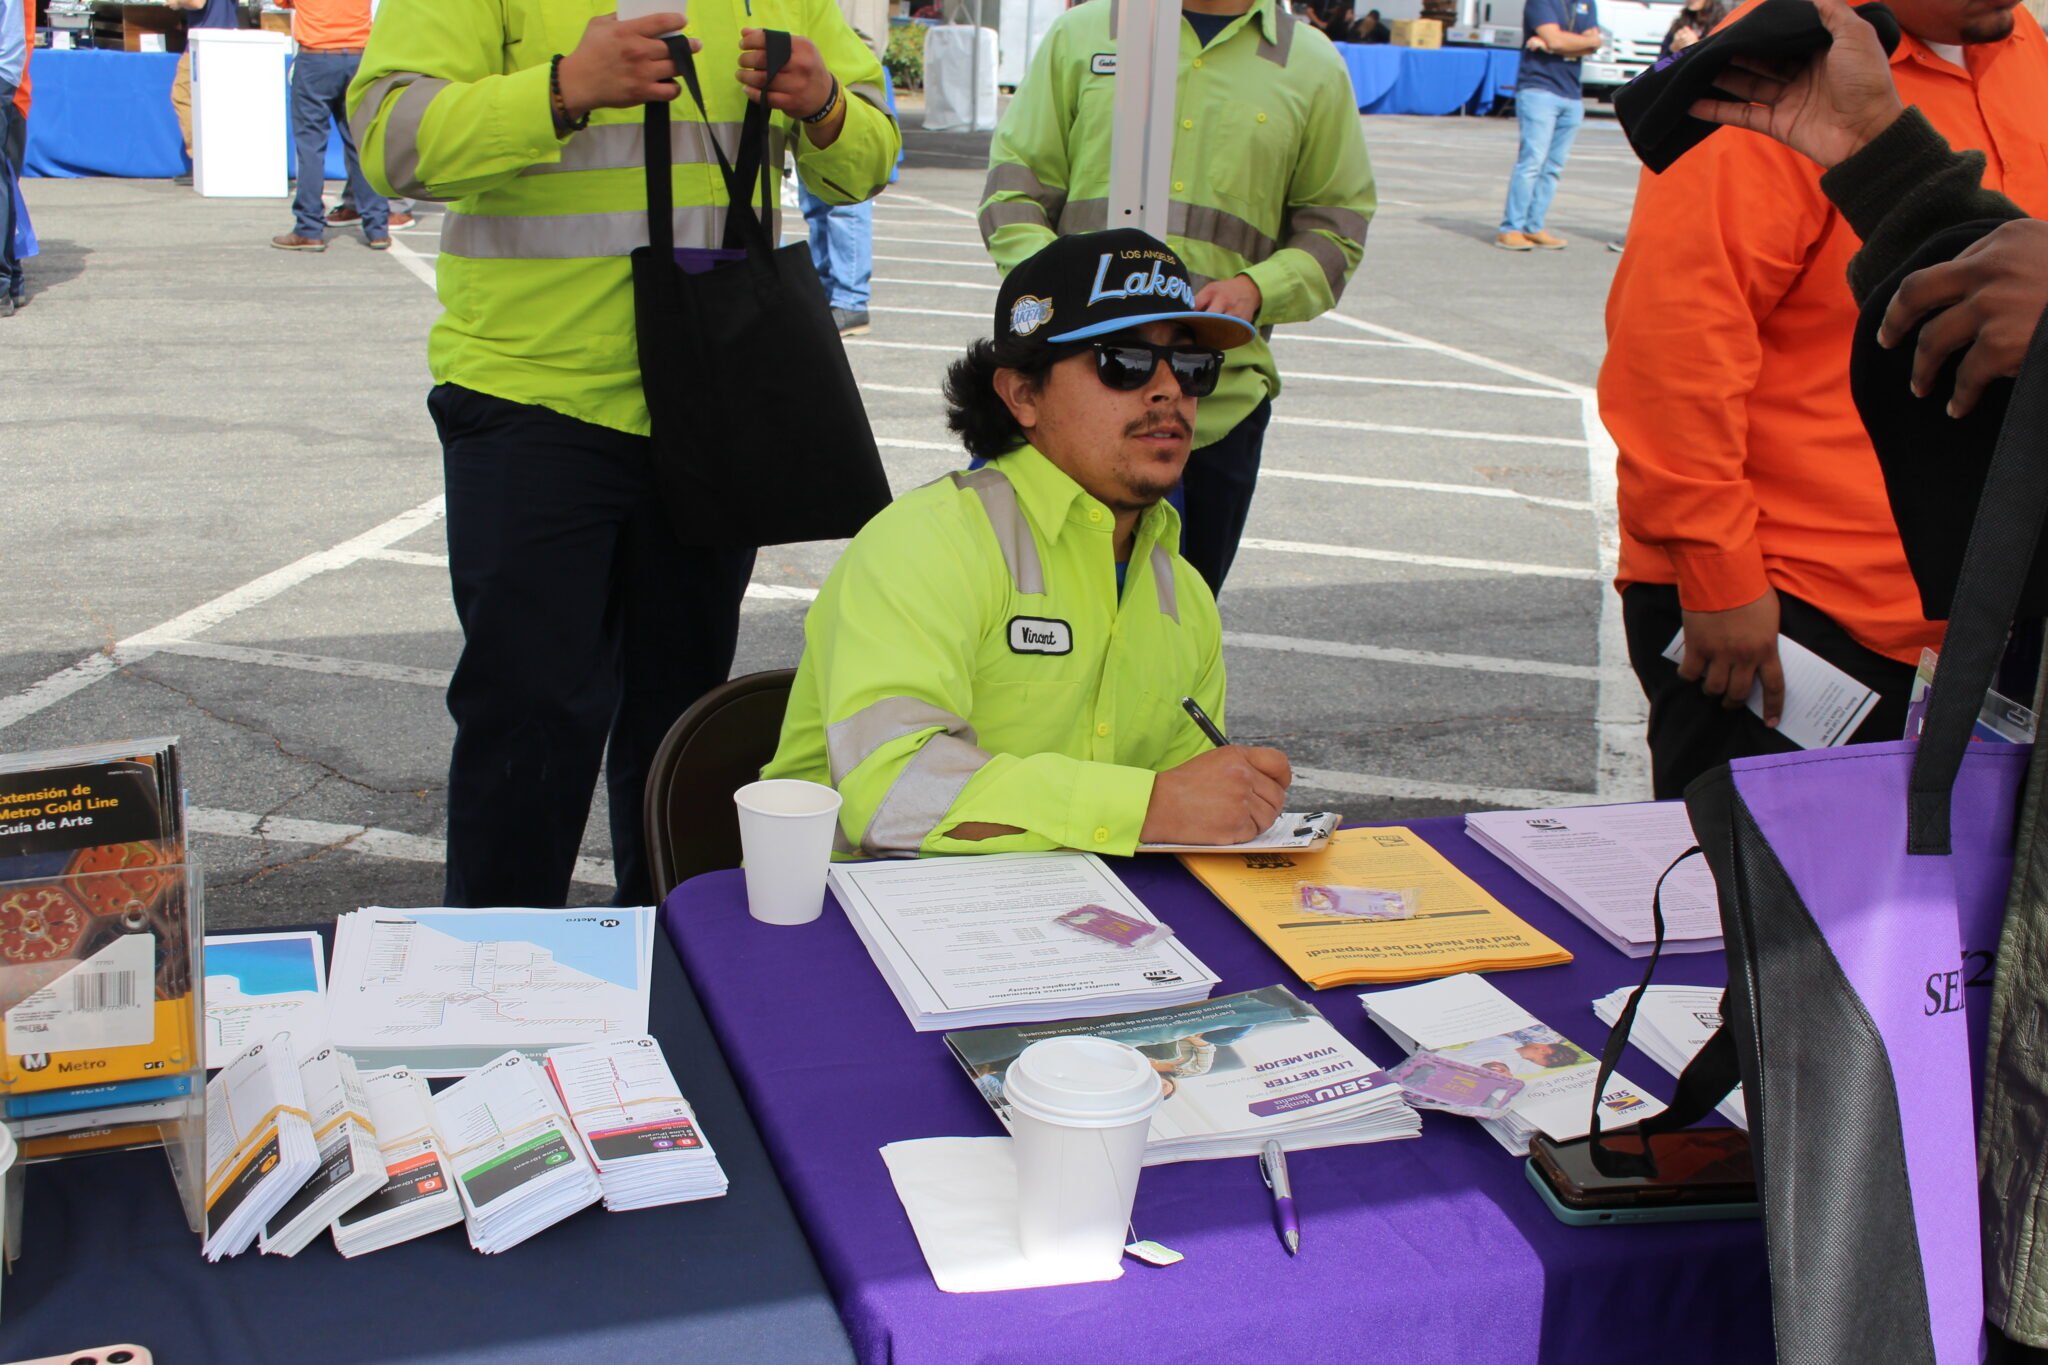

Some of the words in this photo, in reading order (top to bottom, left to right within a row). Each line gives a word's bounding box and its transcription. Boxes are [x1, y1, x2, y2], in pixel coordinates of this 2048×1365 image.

[1120, 250, 1141, 260] LOS
[71, 784, 91, 796] de
[0, 807, 42, 821] Metro
[45, 800, 82, 815] Gold
[87, 798, 119, 810] Line
[0, 823, 33, 835] Guía
[36, 819, 56, 831] de
[59, 815, 94, 829] Arte
[1423, 940, 1465, 949] Need
[1305, 946, 1382, 958] Prepared!
[1303, 1047, 1337, 1060] VIVA
[58, 1060, 107, 1074] Metro
[1254, 1055, 1303, 1073] MEJOR
[1320, 1060, 1354, 1074] LIVE
[1264, 1069, 1320, 1089] BETTER
[1315, 1077, 1373, 1102] SEIU
[1599, 1090, 1631, 1103] SEIU
